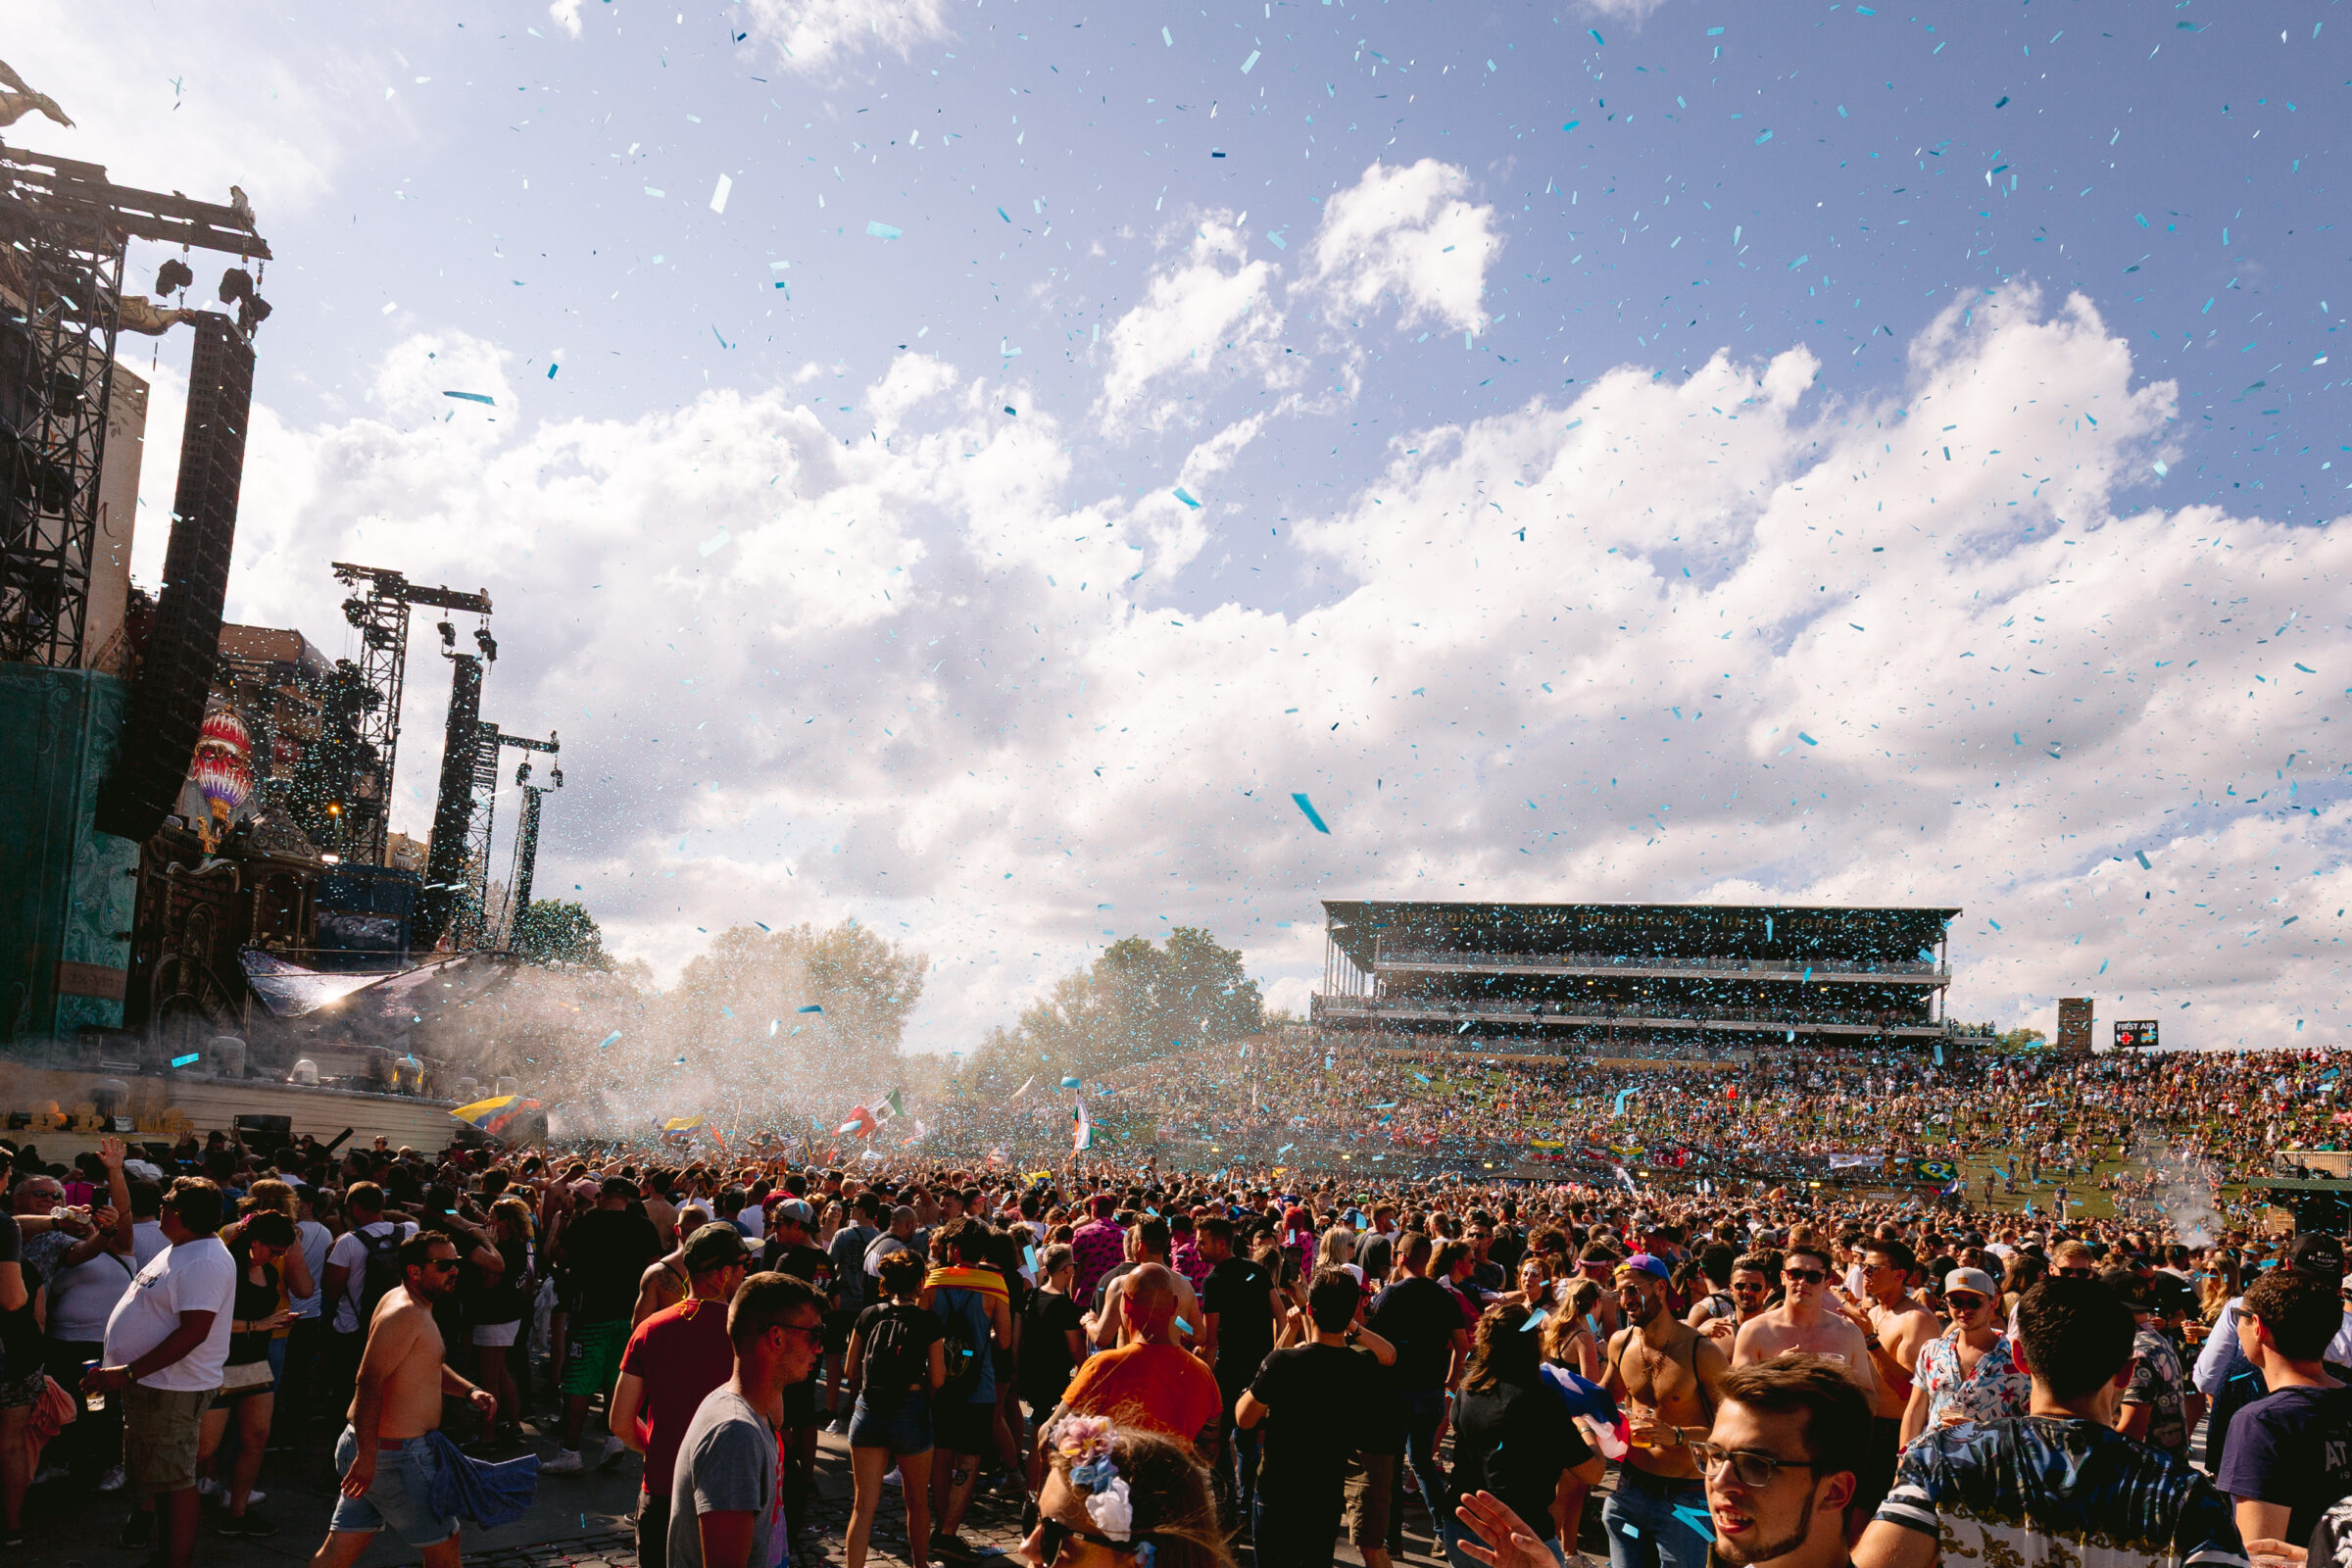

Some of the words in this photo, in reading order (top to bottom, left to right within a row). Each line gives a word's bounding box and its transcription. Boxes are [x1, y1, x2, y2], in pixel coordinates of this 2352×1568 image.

[1435, 911, 1492, 924] TODAY
[1576, 913, 1688, 926] TOMORROW
[2325, 1441, 2352, 1472] AT
